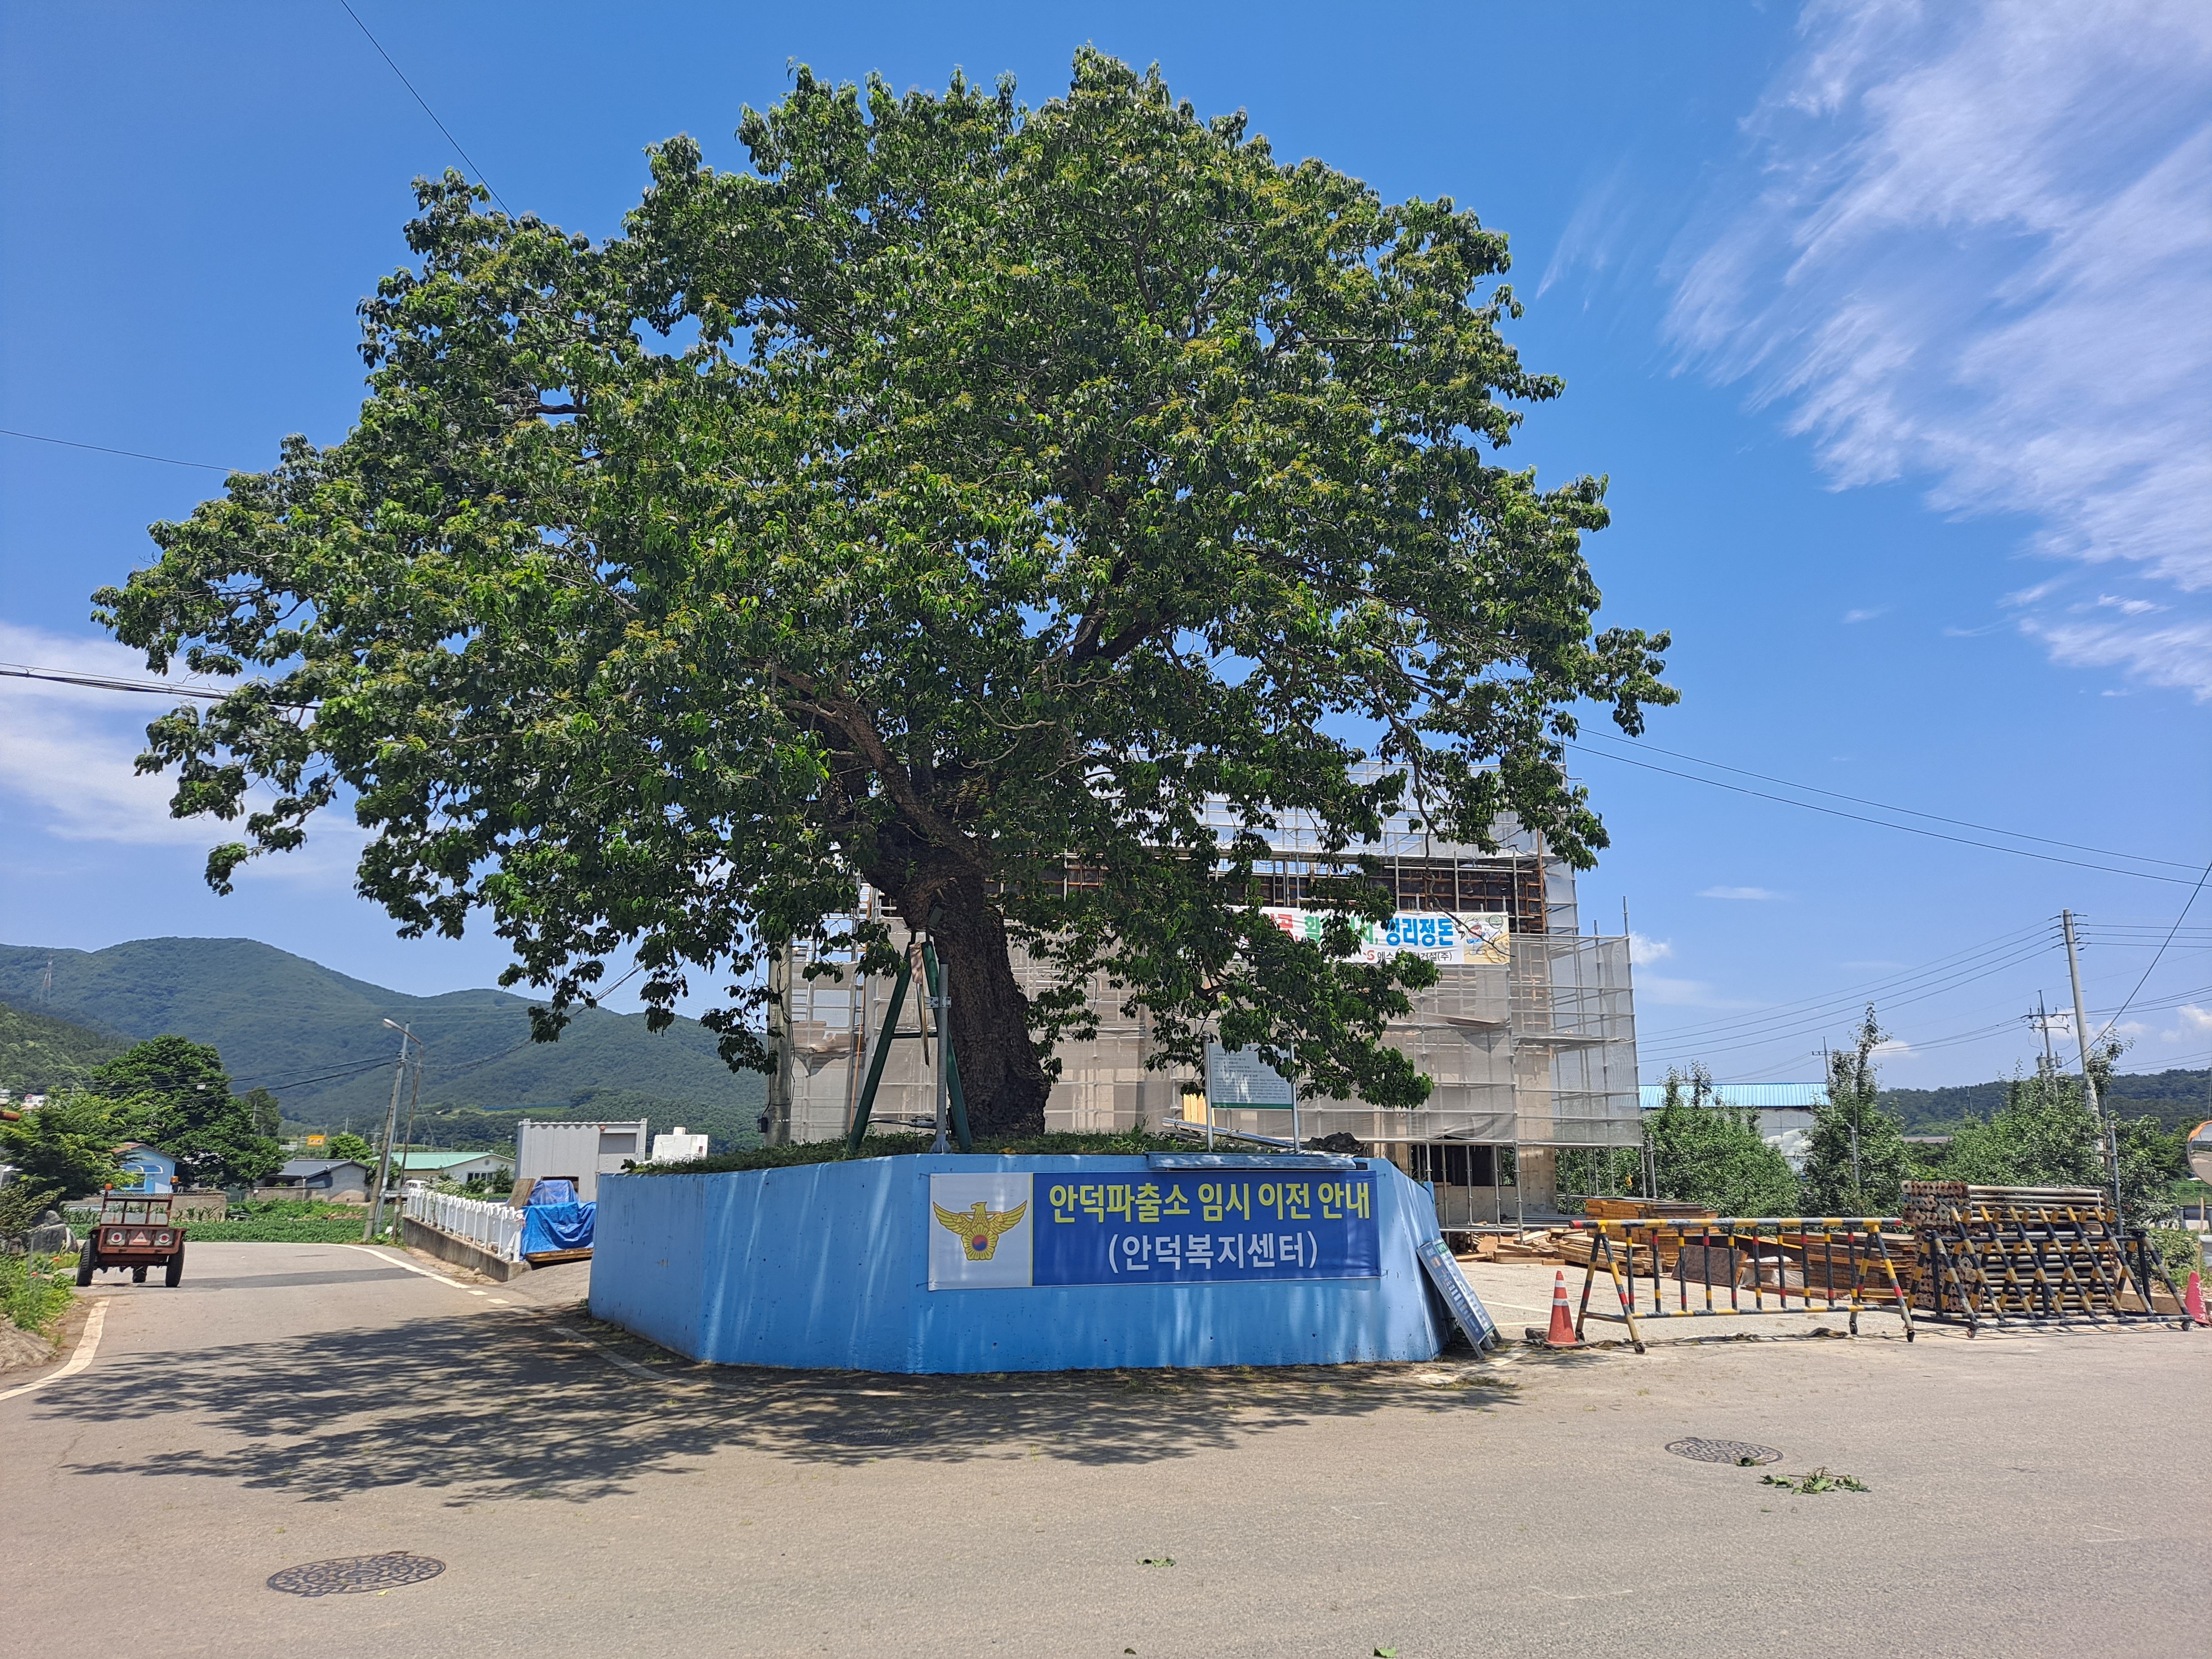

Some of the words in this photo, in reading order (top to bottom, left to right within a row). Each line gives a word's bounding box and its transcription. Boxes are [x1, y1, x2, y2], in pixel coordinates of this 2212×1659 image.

[1049, 1182, 1190, 1223] 안덕파출소
[1198, 1183, 1250, 1222] 임시
[1258, 1182, 1311, 1220] 이전
[1318, 1182, 1370, 1219] 안내
[1108, 1230, 1318, 1274] (안덕복지센터)
